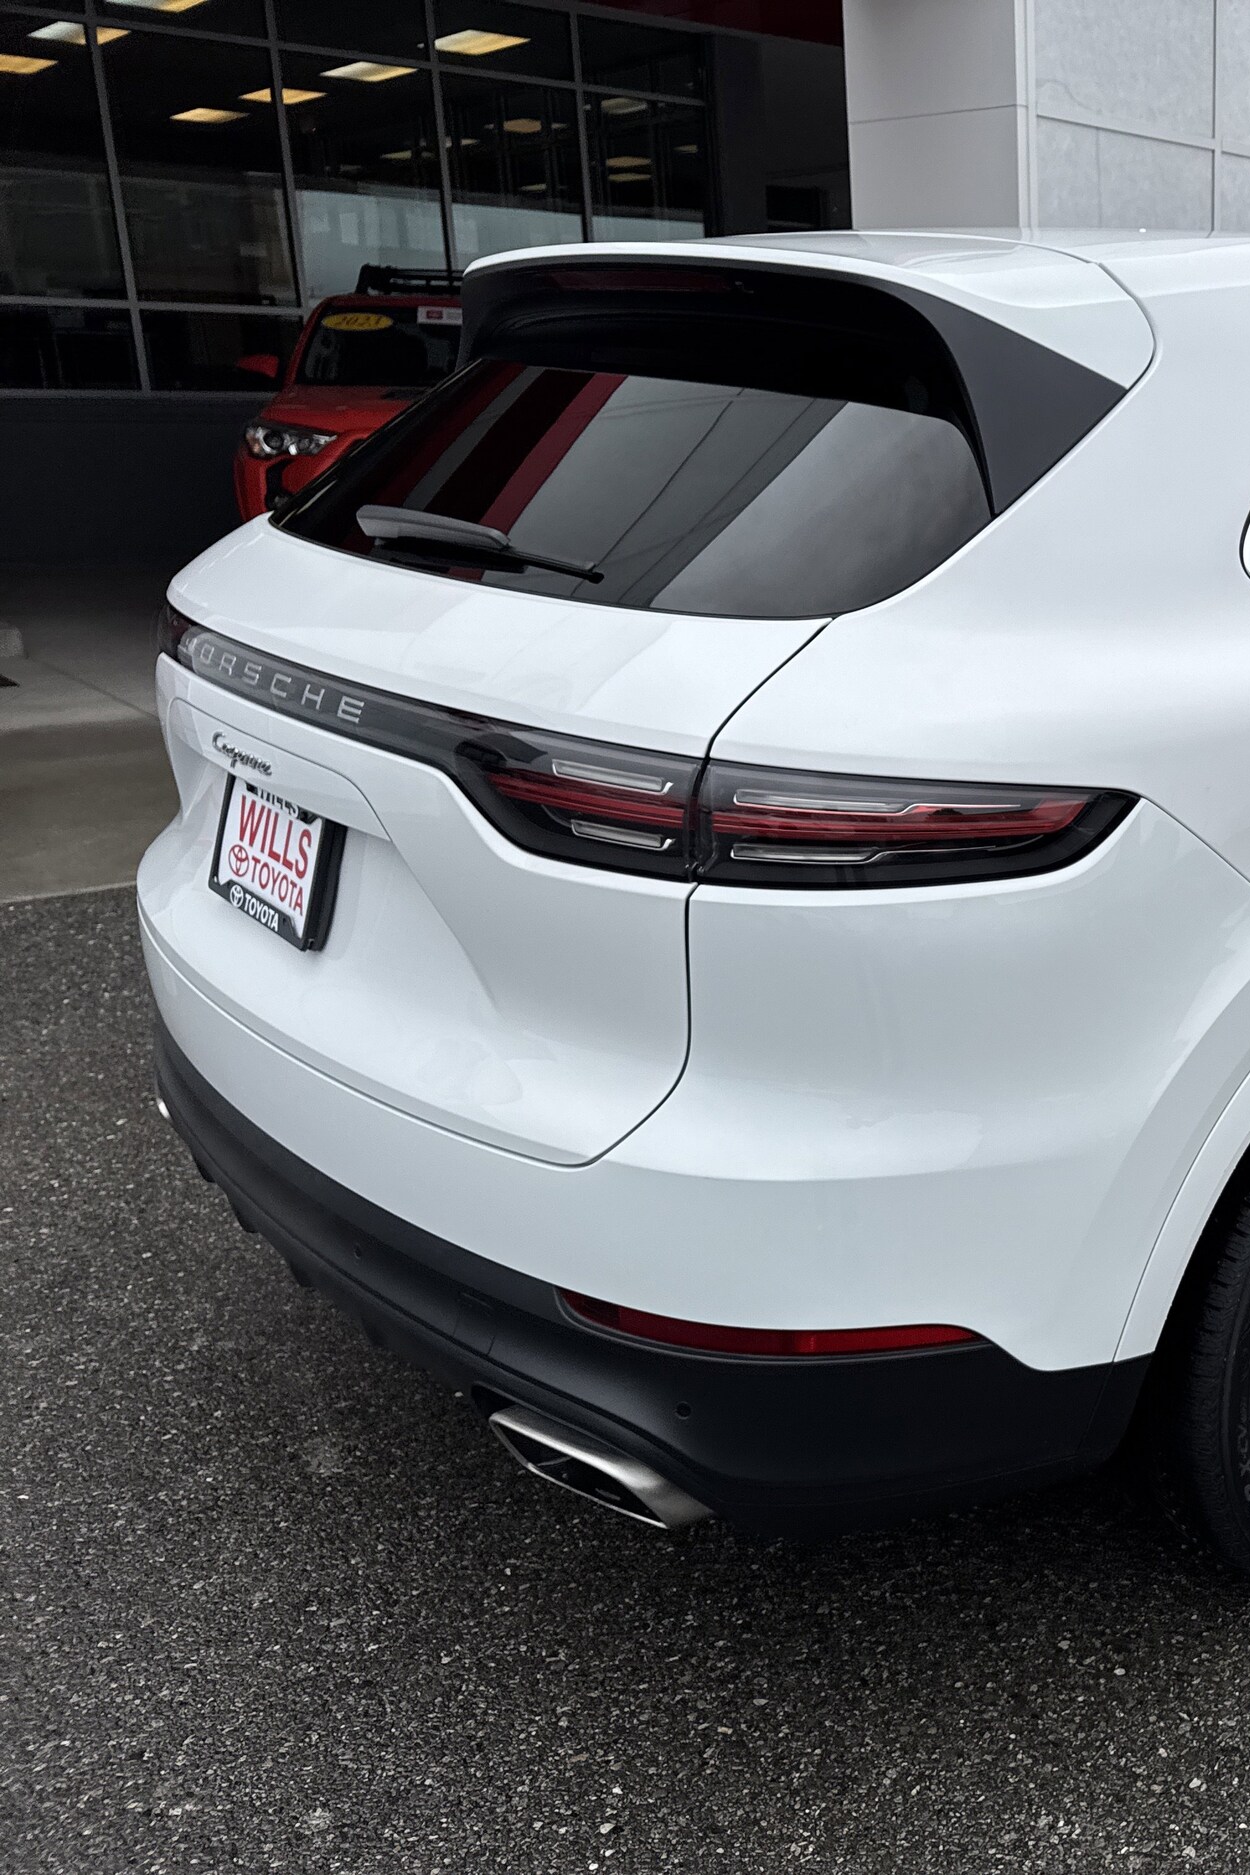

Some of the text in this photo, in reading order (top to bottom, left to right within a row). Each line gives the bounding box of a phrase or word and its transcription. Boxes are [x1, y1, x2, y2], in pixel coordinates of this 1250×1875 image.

[239, 794, 312, 880] WILLS
[243, 893, 279, 932] TOYOTA
[251, 855, 304, 917] TOYOTA
